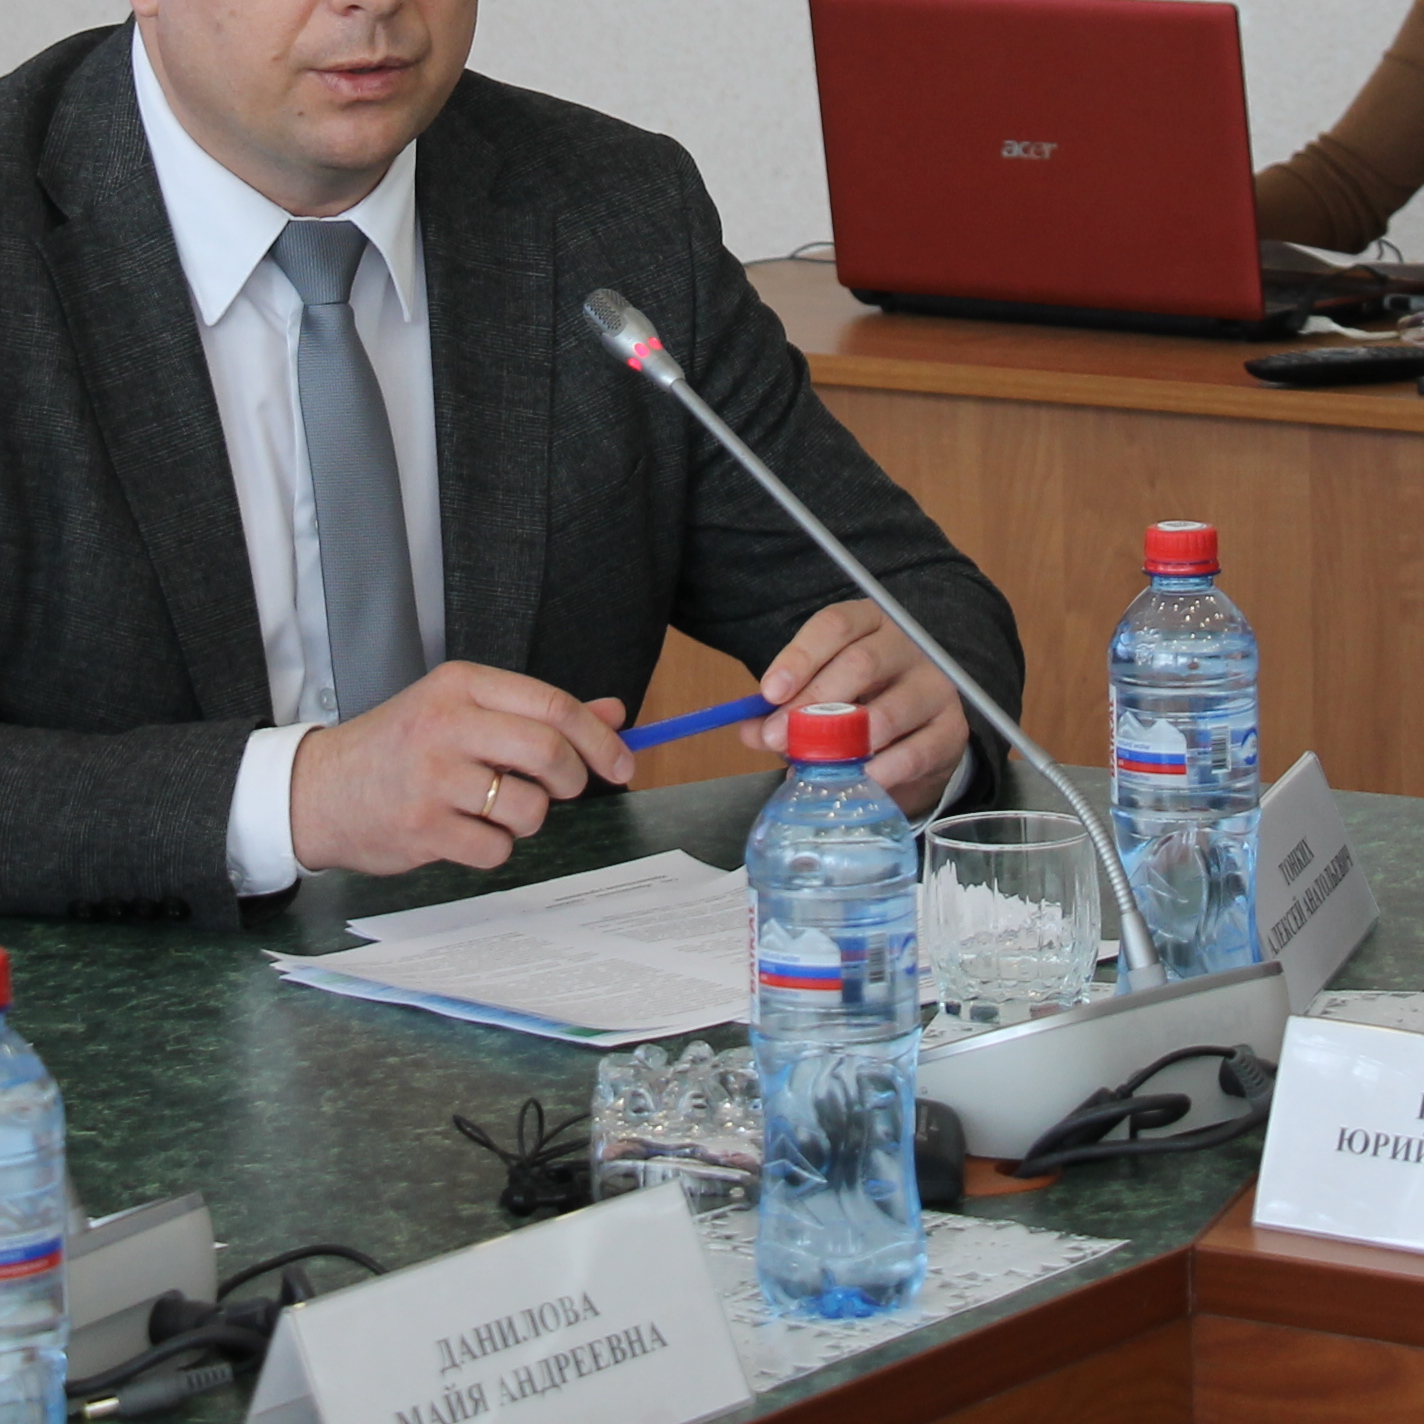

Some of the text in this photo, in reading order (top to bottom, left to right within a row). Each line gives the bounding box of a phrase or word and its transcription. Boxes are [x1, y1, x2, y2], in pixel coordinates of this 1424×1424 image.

[1000, 139, 1059, 160] acer
[434, 1291, 601, 1375] ДАНИЛОВА
[499, 1321, 668, 1407] АНДРЕЕВНА
